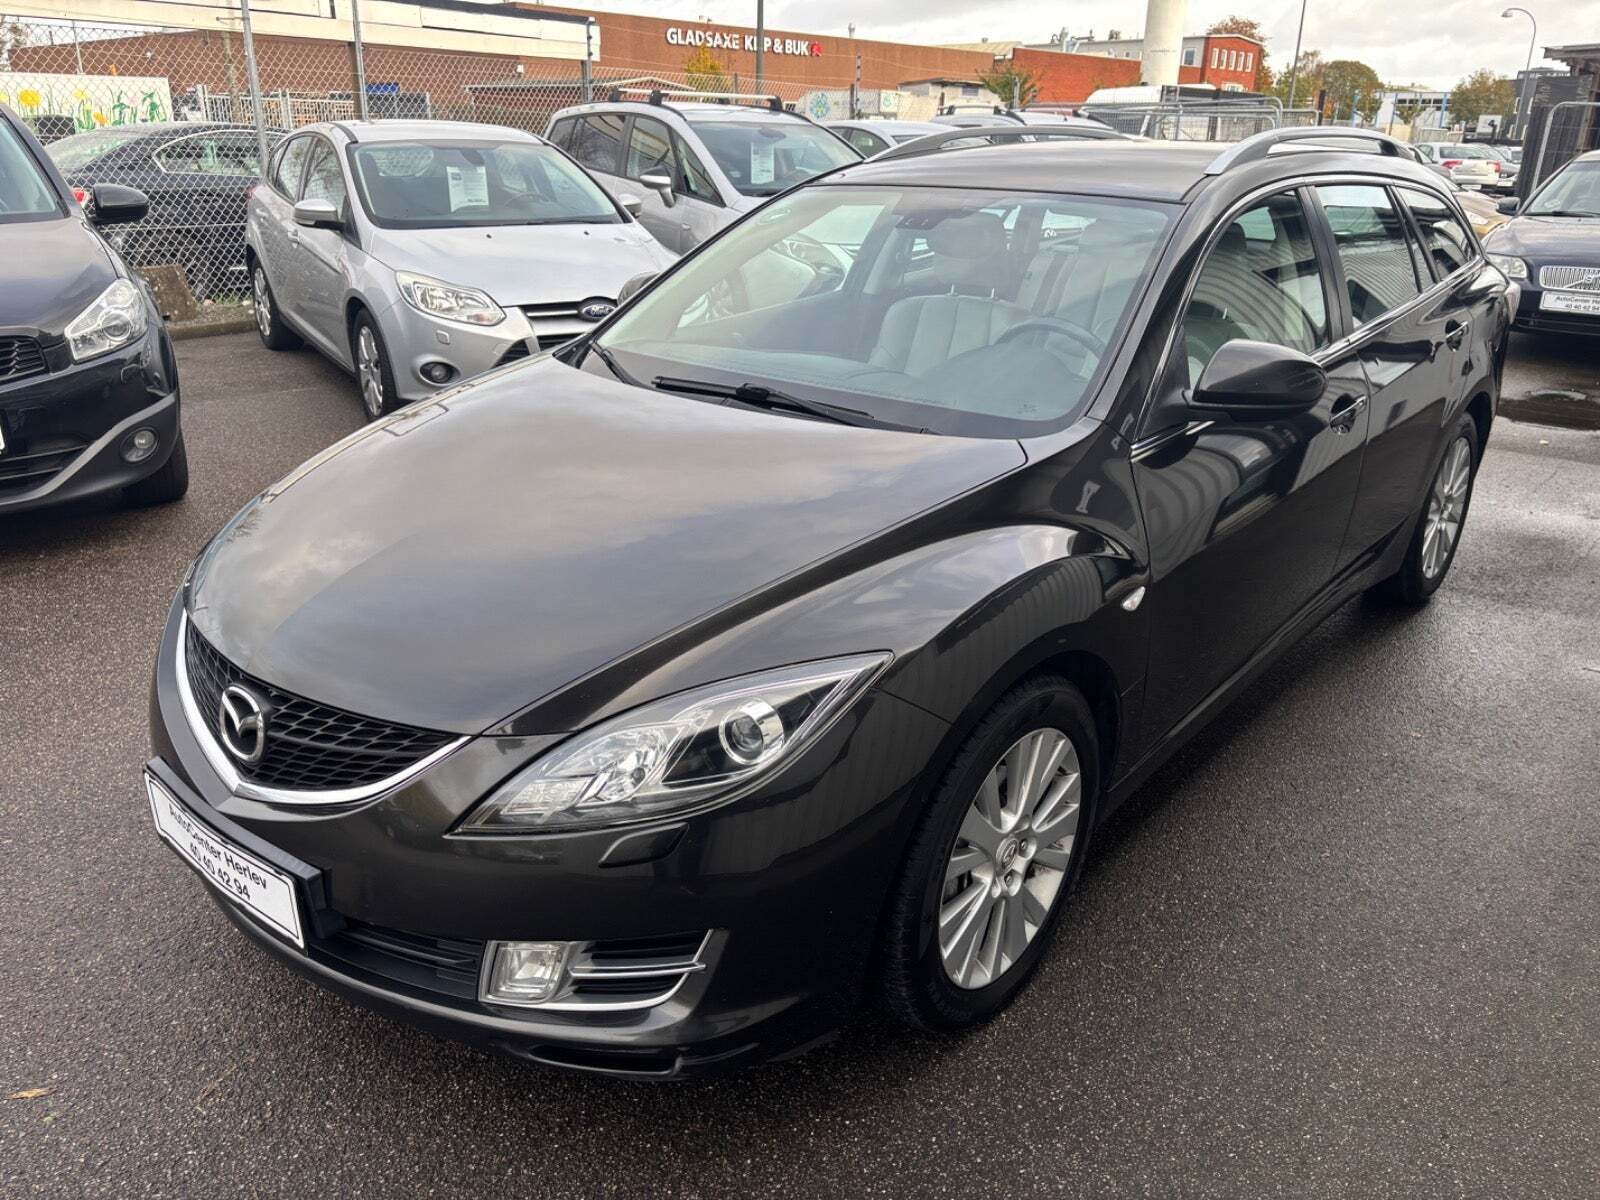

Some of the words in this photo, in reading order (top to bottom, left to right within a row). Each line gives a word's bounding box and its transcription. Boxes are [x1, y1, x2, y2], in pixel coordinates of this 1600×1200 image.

[666, 27, 740, 49] GLADSAXE
[773, 38, 783, 53] &
[785, 38, 809, 56] BUK
[203, 855, 215, 875] 40
[218, 868, 233, 889] 42
[234, 878, 251, 900] 94
[224, 851, 267, 889] Herlev
